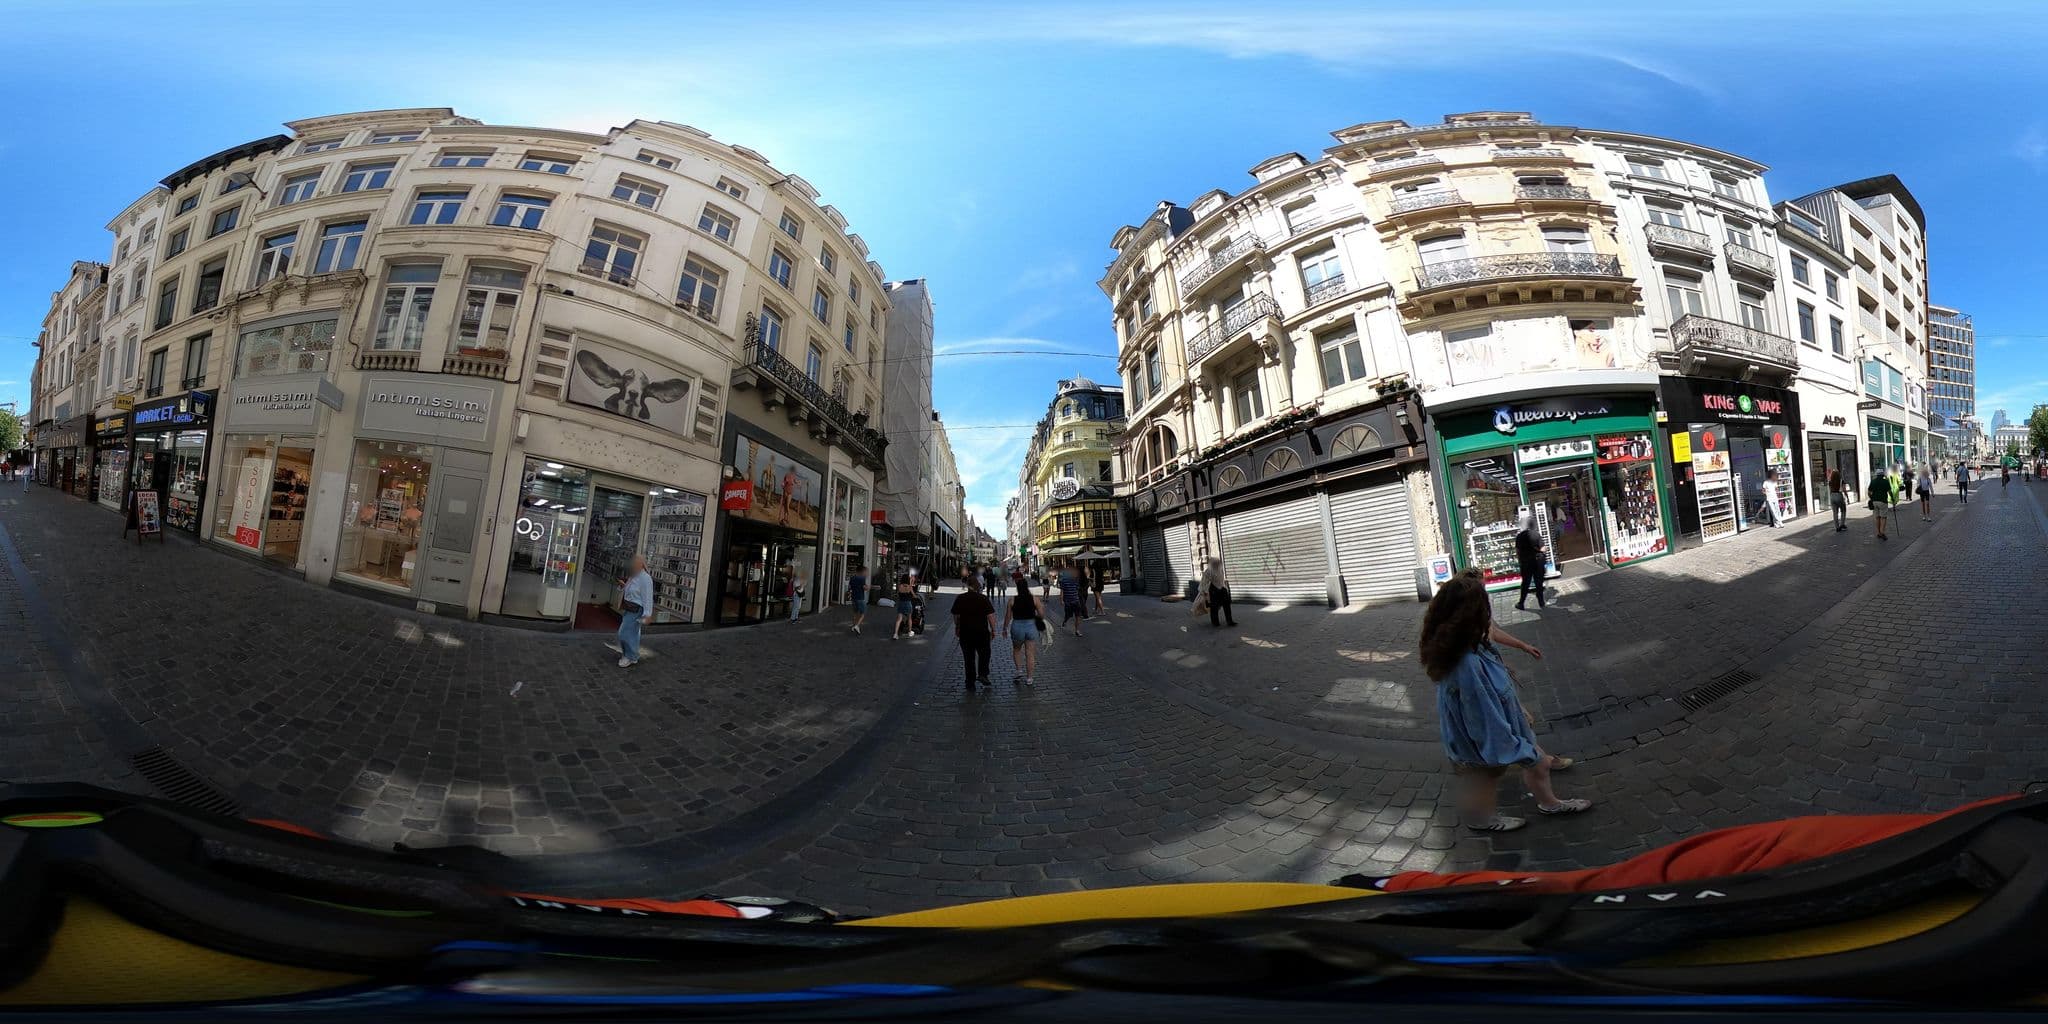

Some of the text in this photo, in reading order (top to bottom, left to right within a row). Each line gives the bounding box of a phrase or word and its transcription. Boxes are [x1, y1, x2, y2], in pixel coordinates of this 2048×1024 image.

[235, 392, 312, 404] intimissimi
[371, 393, 488, 412] intimissimi
[1703, 395, 1782, 414] KING VAPE
[135, 405, 175, 424] MARKET
[415, 407, 445, 418] Italian
[1822, 414, 1846, 427] ALDO
[724, 489, 748, 501] CAMPER
[240, 530, 255, 545] 50
